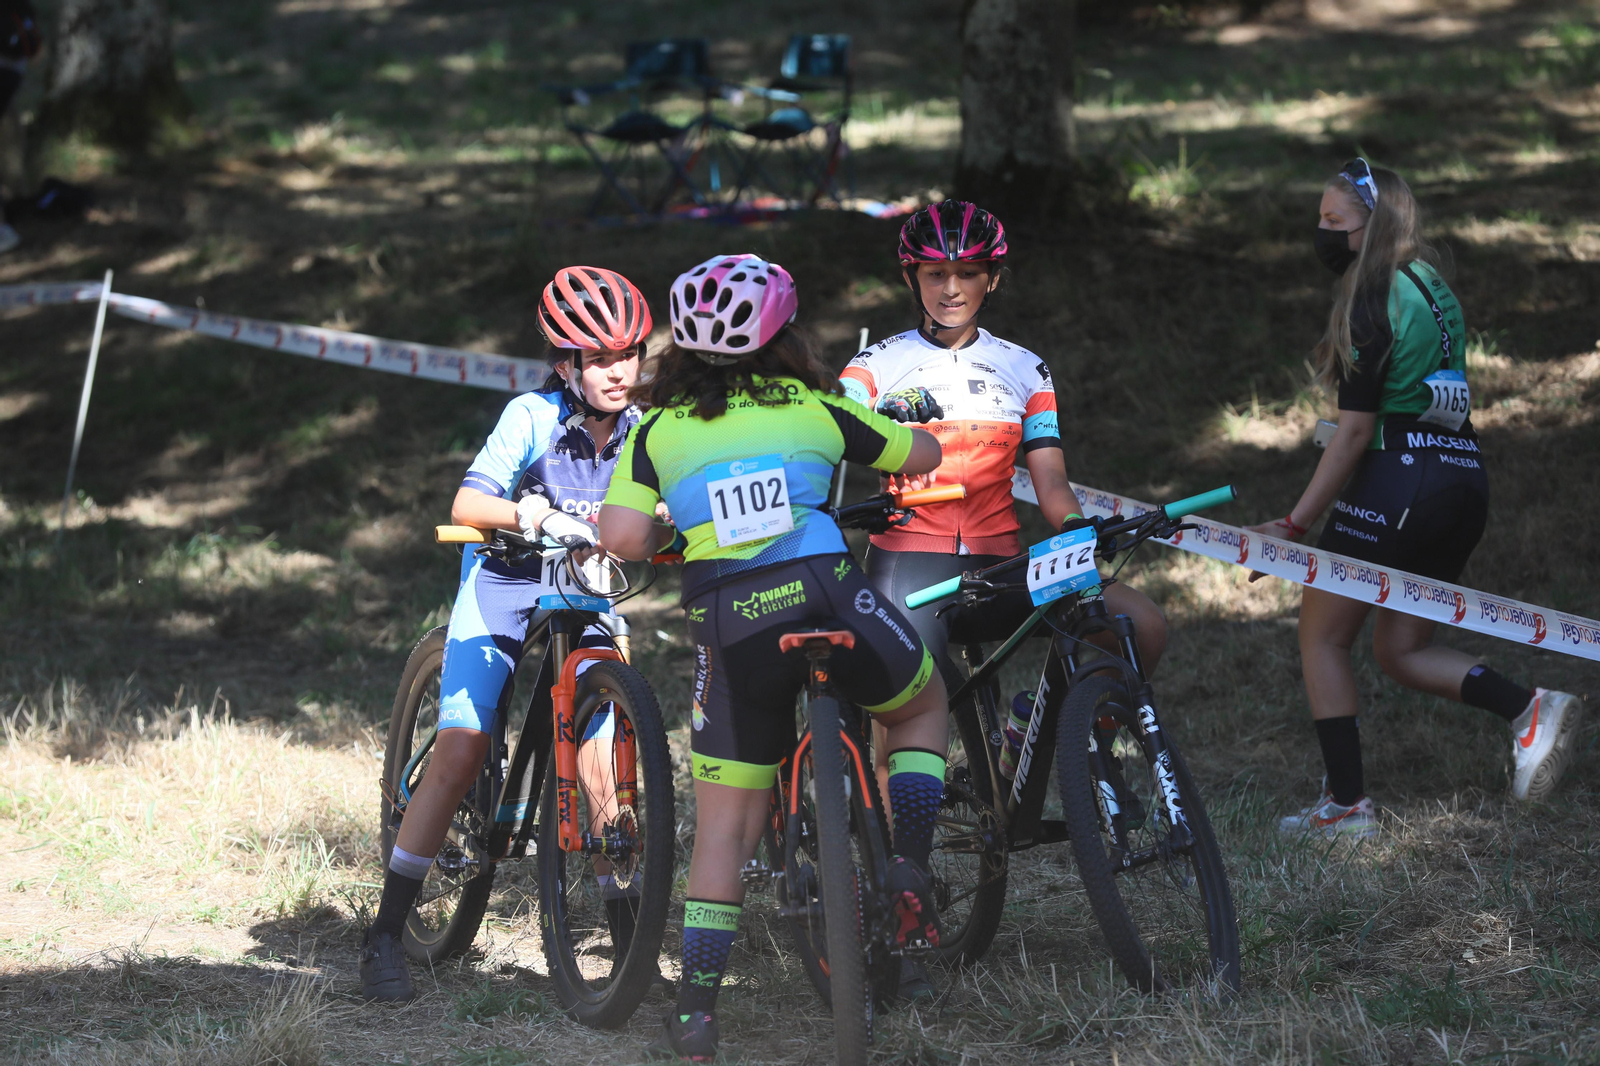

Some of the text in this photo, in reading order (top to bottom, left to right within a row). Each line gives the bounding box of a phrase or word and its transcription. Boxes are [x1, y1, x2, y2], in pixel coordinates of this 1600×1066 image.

[1434, 385, 1467, 413] 1165
[1406, 432, 1481, 453] MACEDA
[1439, 453, 1480, 469] MACEDA
[714, 477, 785, 520] 1102
[1343, 526, 1378, 543] PERSAN
[1033, 546, 1091, 581] 1112
[759, 579, 804, 604] AVANZA
[761, 594, 806, 615] CICLISMO
[557, 711, 576, 744] 32
[1012, 675, 1050, 805] MERIDA
[558, 789, 571, 826] FOX
